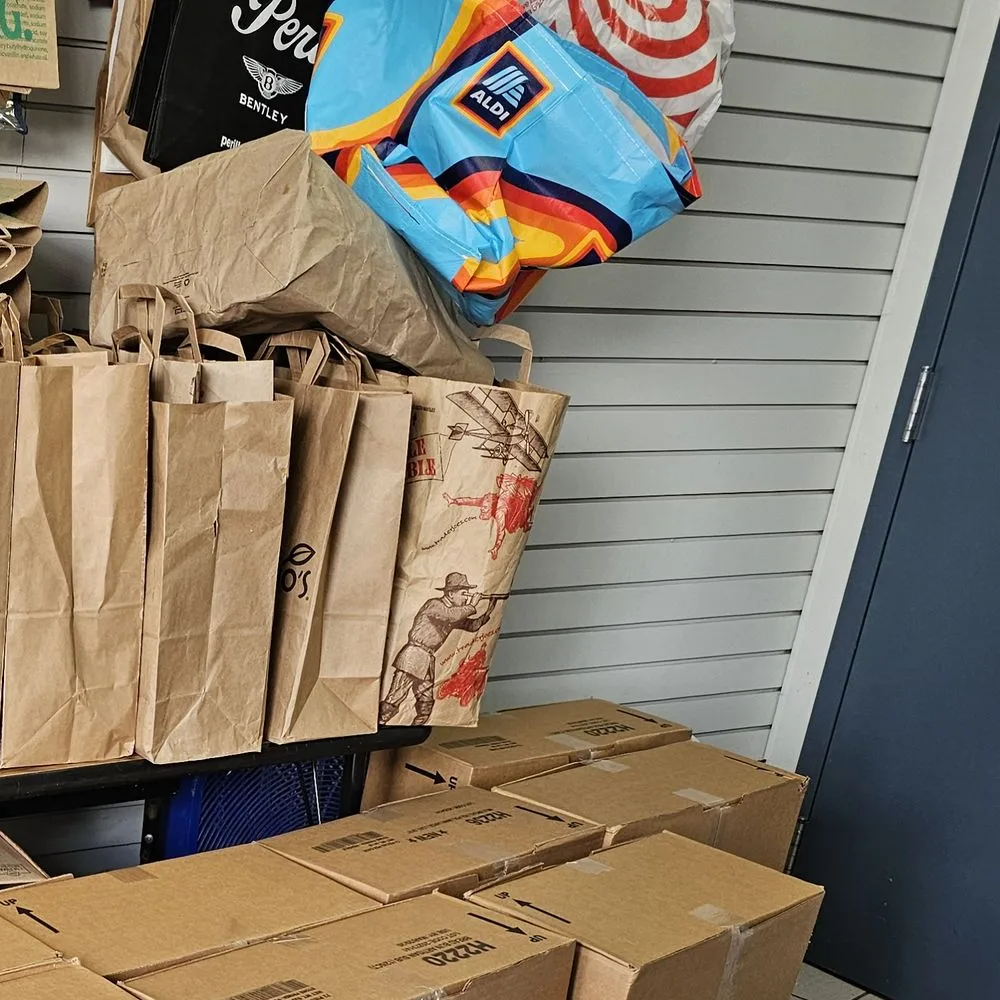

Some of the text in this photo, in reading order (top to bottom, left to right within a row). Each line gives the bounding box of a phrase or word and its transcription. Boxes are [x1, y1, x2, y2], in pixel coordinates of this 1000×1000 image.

[239, 92, 288, 125] BENTLEY
[469, 89, 510, 121] ALDI
[0, 898, 18, 907] UP
[494, 891, 510, 899] UP
[529, 934, 548, 943] UP
[422, 940, 496, 967] H2220
